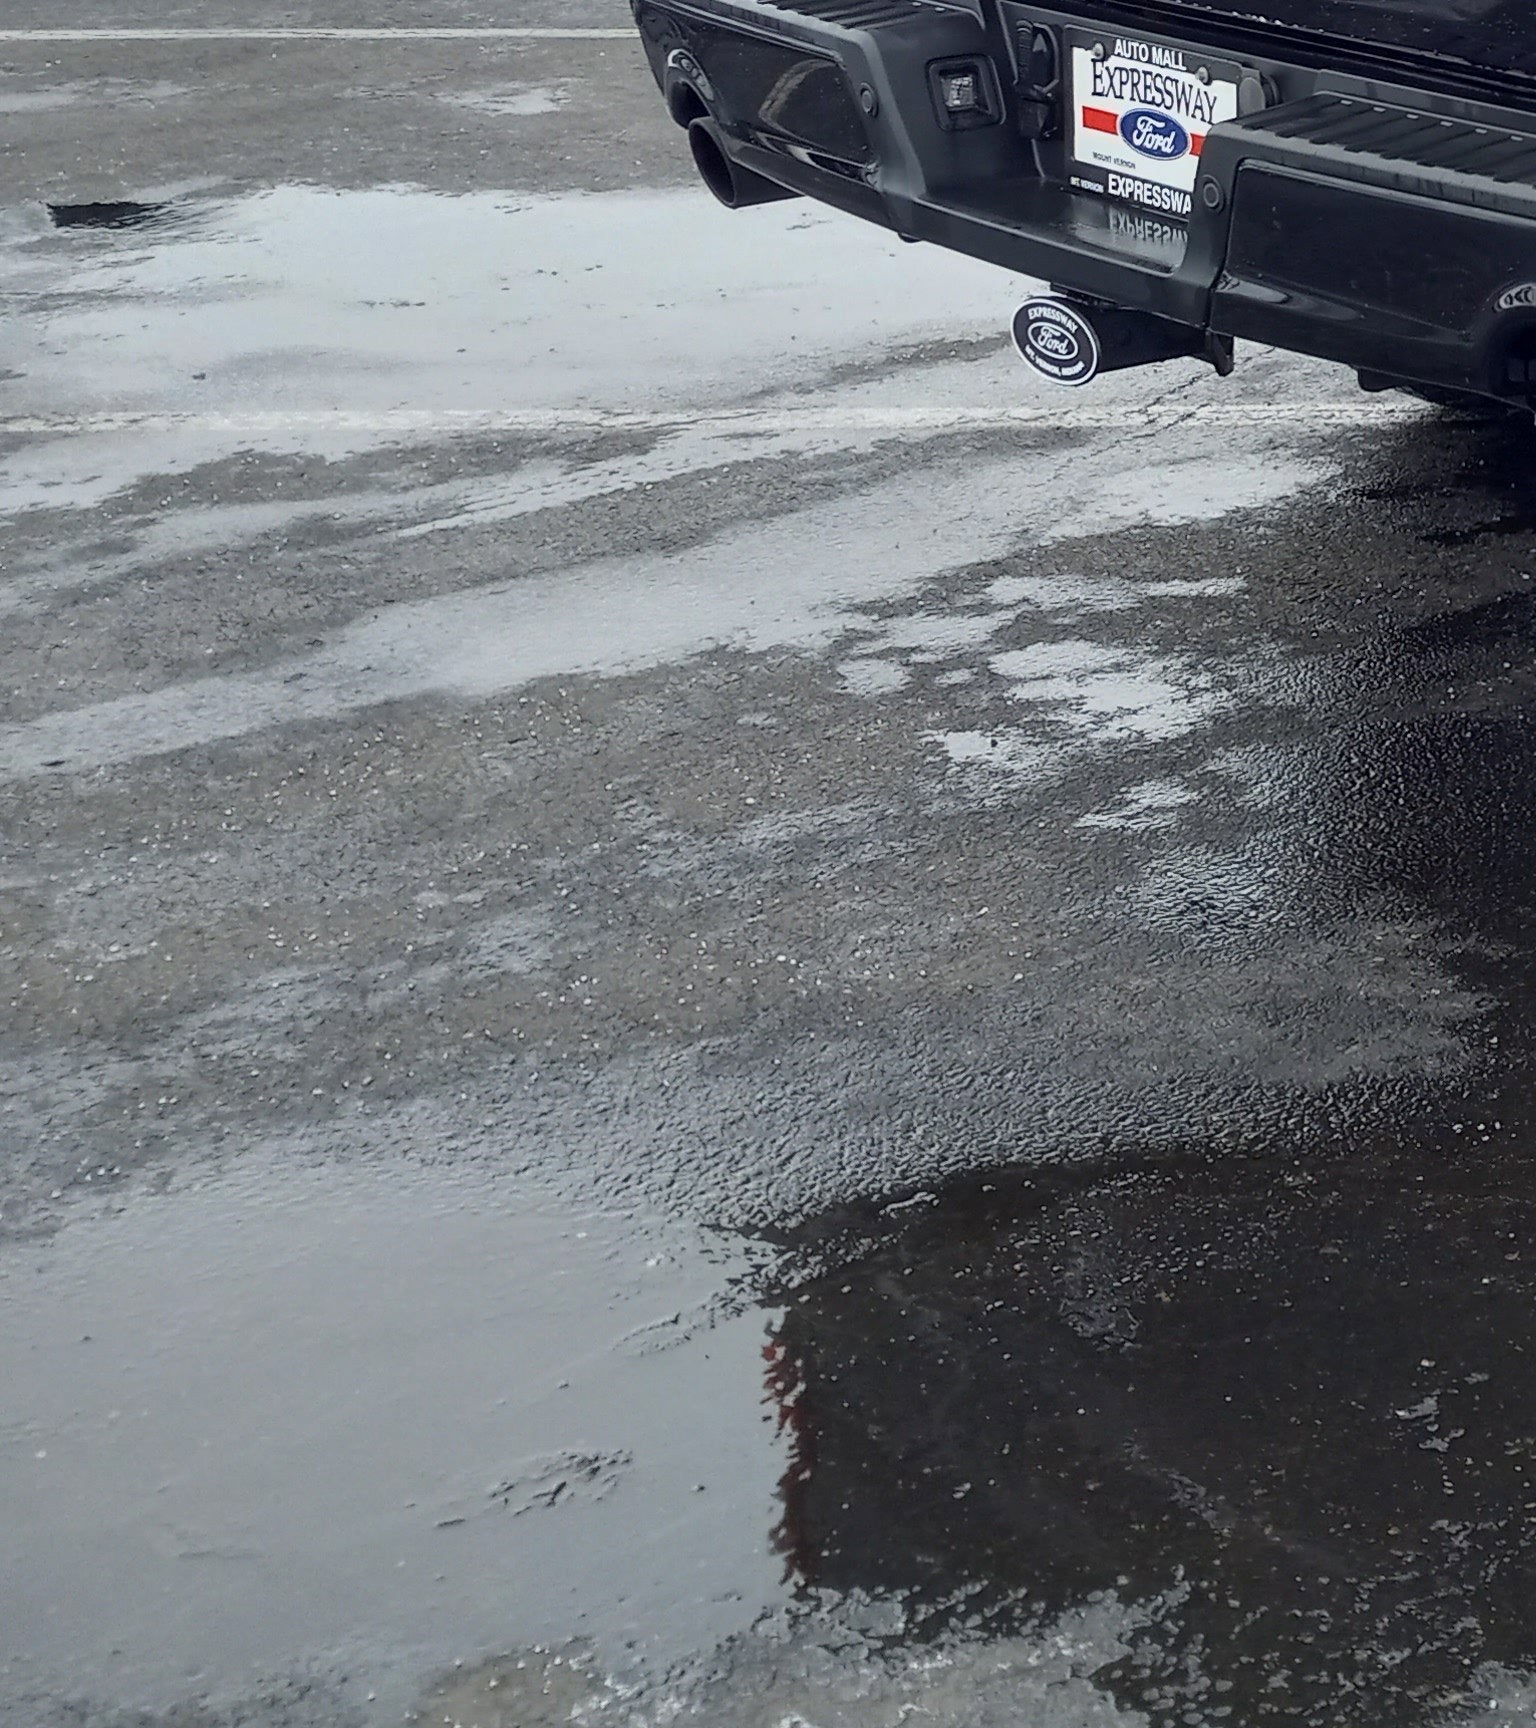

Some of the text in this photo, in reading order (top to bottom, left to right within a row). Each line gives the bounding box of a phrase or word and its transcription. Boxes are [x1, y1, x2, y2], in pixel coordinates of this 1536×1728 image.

[1113, 39, 1187, 71] AUTO MALL
[1091, 58, 1218, 124] EXPRESSWAY
[1132, 115, 1176, 154] Ford
[1028, 306, 1078, 334] EXPRESSWAY
[1037, 326, 1069, 355] Ford
